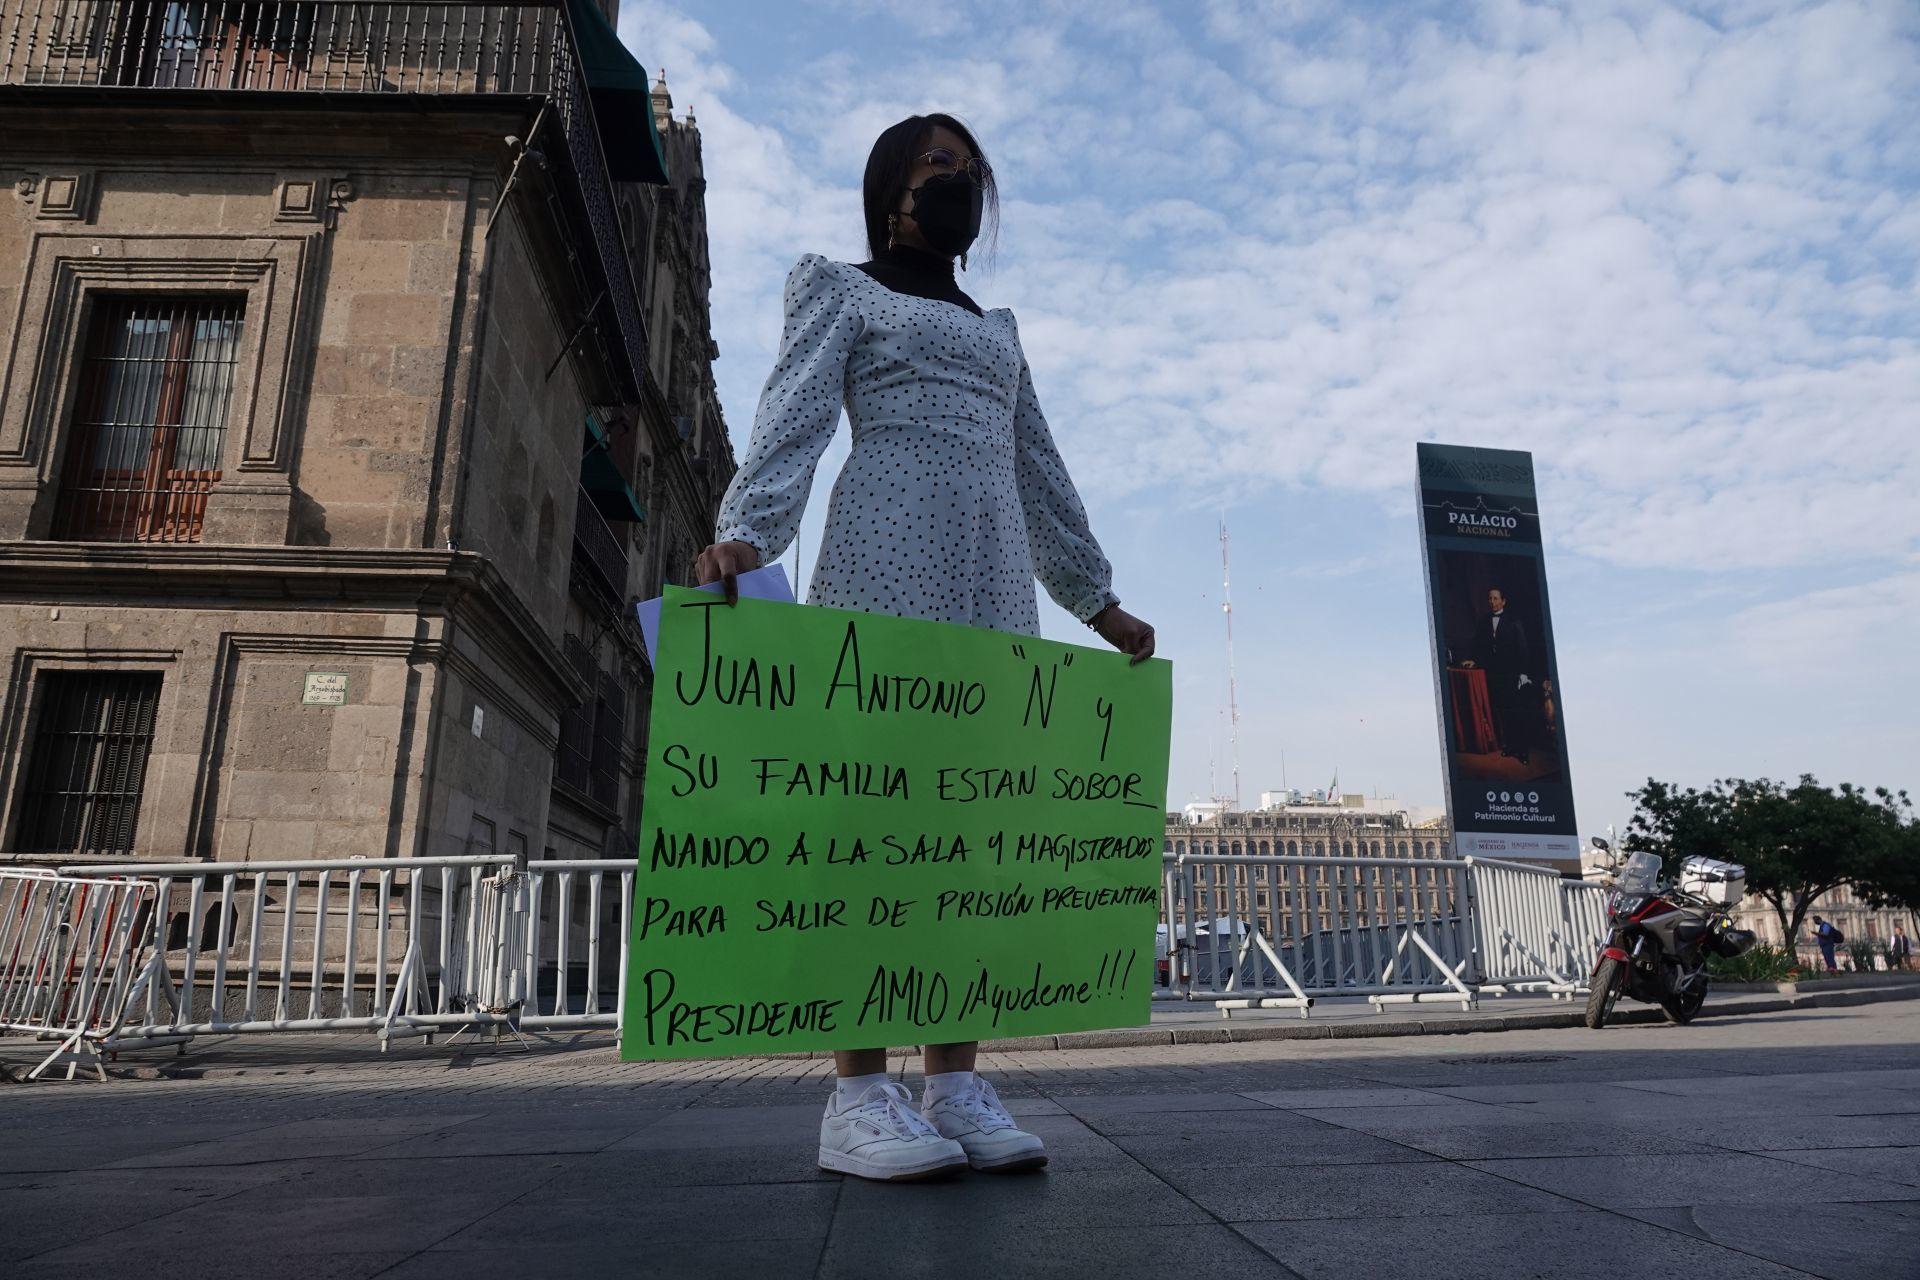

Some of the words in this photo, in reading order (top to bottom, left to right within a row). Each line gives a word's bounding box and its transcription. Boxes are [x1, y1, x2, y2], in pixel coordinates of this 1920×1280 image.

[1448, 512, 1517, 528] PALACIO
[1457, 526, 1511, 537] NACIONAL
[676, 602, 795, 710] JUAN
[825, 621, 985, 715] ANTONIO
[663, 745, 718, 797] SU
[751, 758, 908, 800] FAMILIA
[937, 765, 1036, 802] ESTAN
[1474, 812, 1521, 821] Patrimonio
[1522, 813, 1556, 823] Cultural
[1489, 803, 1528, 813] Hacienda
[651, 827, 769, 872] NANDO
[786, 832, 812, 866] A
[827, 837, 874, 865] LA
[882, 834, 972, 866] SALA
[1016, 832, 1155, 872] MAGISTRADOS
[640, 897, 727, 940] PARA
[757, 900, 847, 931] SALIR
[868, 897, 917, 928] DE
[937, 883, 1034, 921] PRISIÓN
[644, 969, 843, 1045] PRESIDENTE
[858, 965, 948, 1026] AMLO
